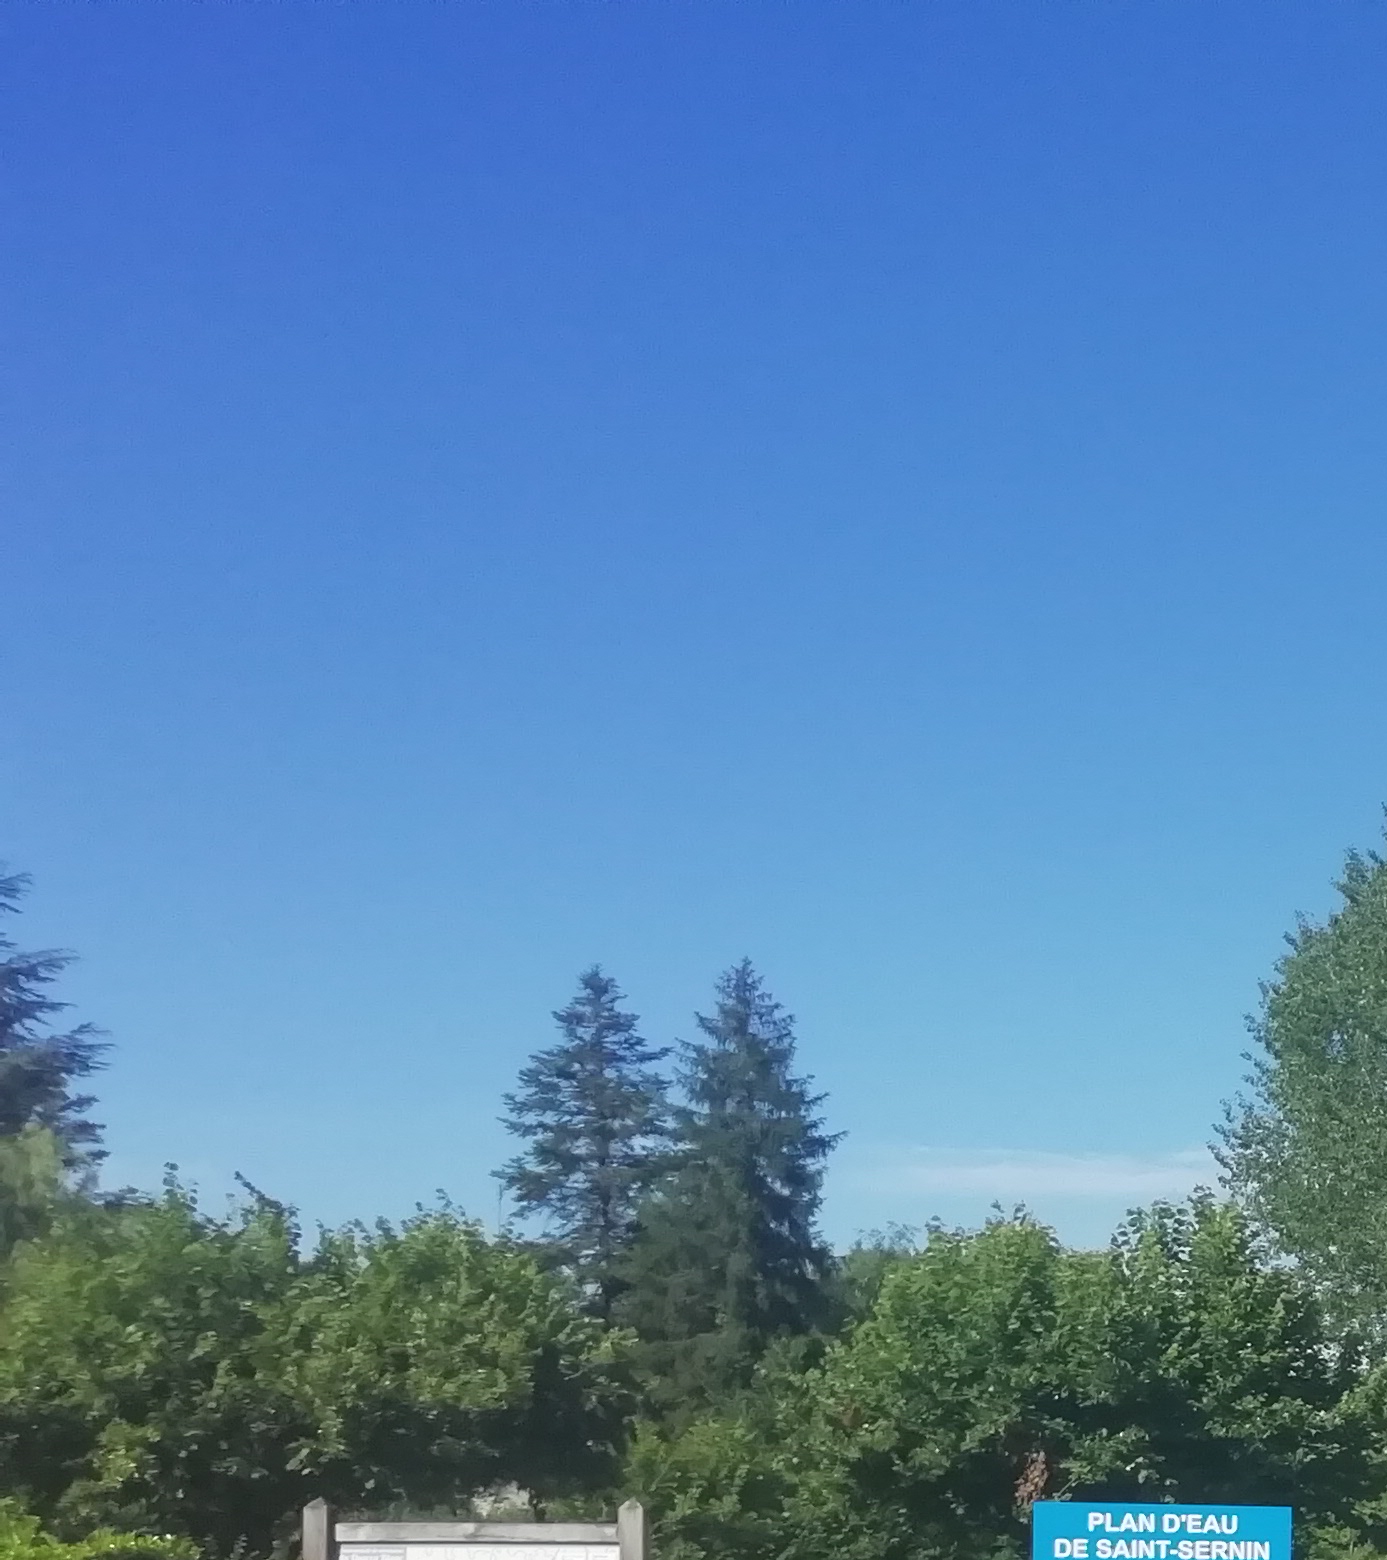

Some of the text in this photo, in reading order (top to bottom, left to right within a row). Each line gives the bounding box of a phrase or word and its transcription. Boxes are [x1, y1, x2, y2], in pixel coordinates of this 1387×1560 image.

[1088, 1512, 1239, 1534] PLAN D'EAU
[1054, 1538, 1271, 1560] DE SAINT-SERNIN
